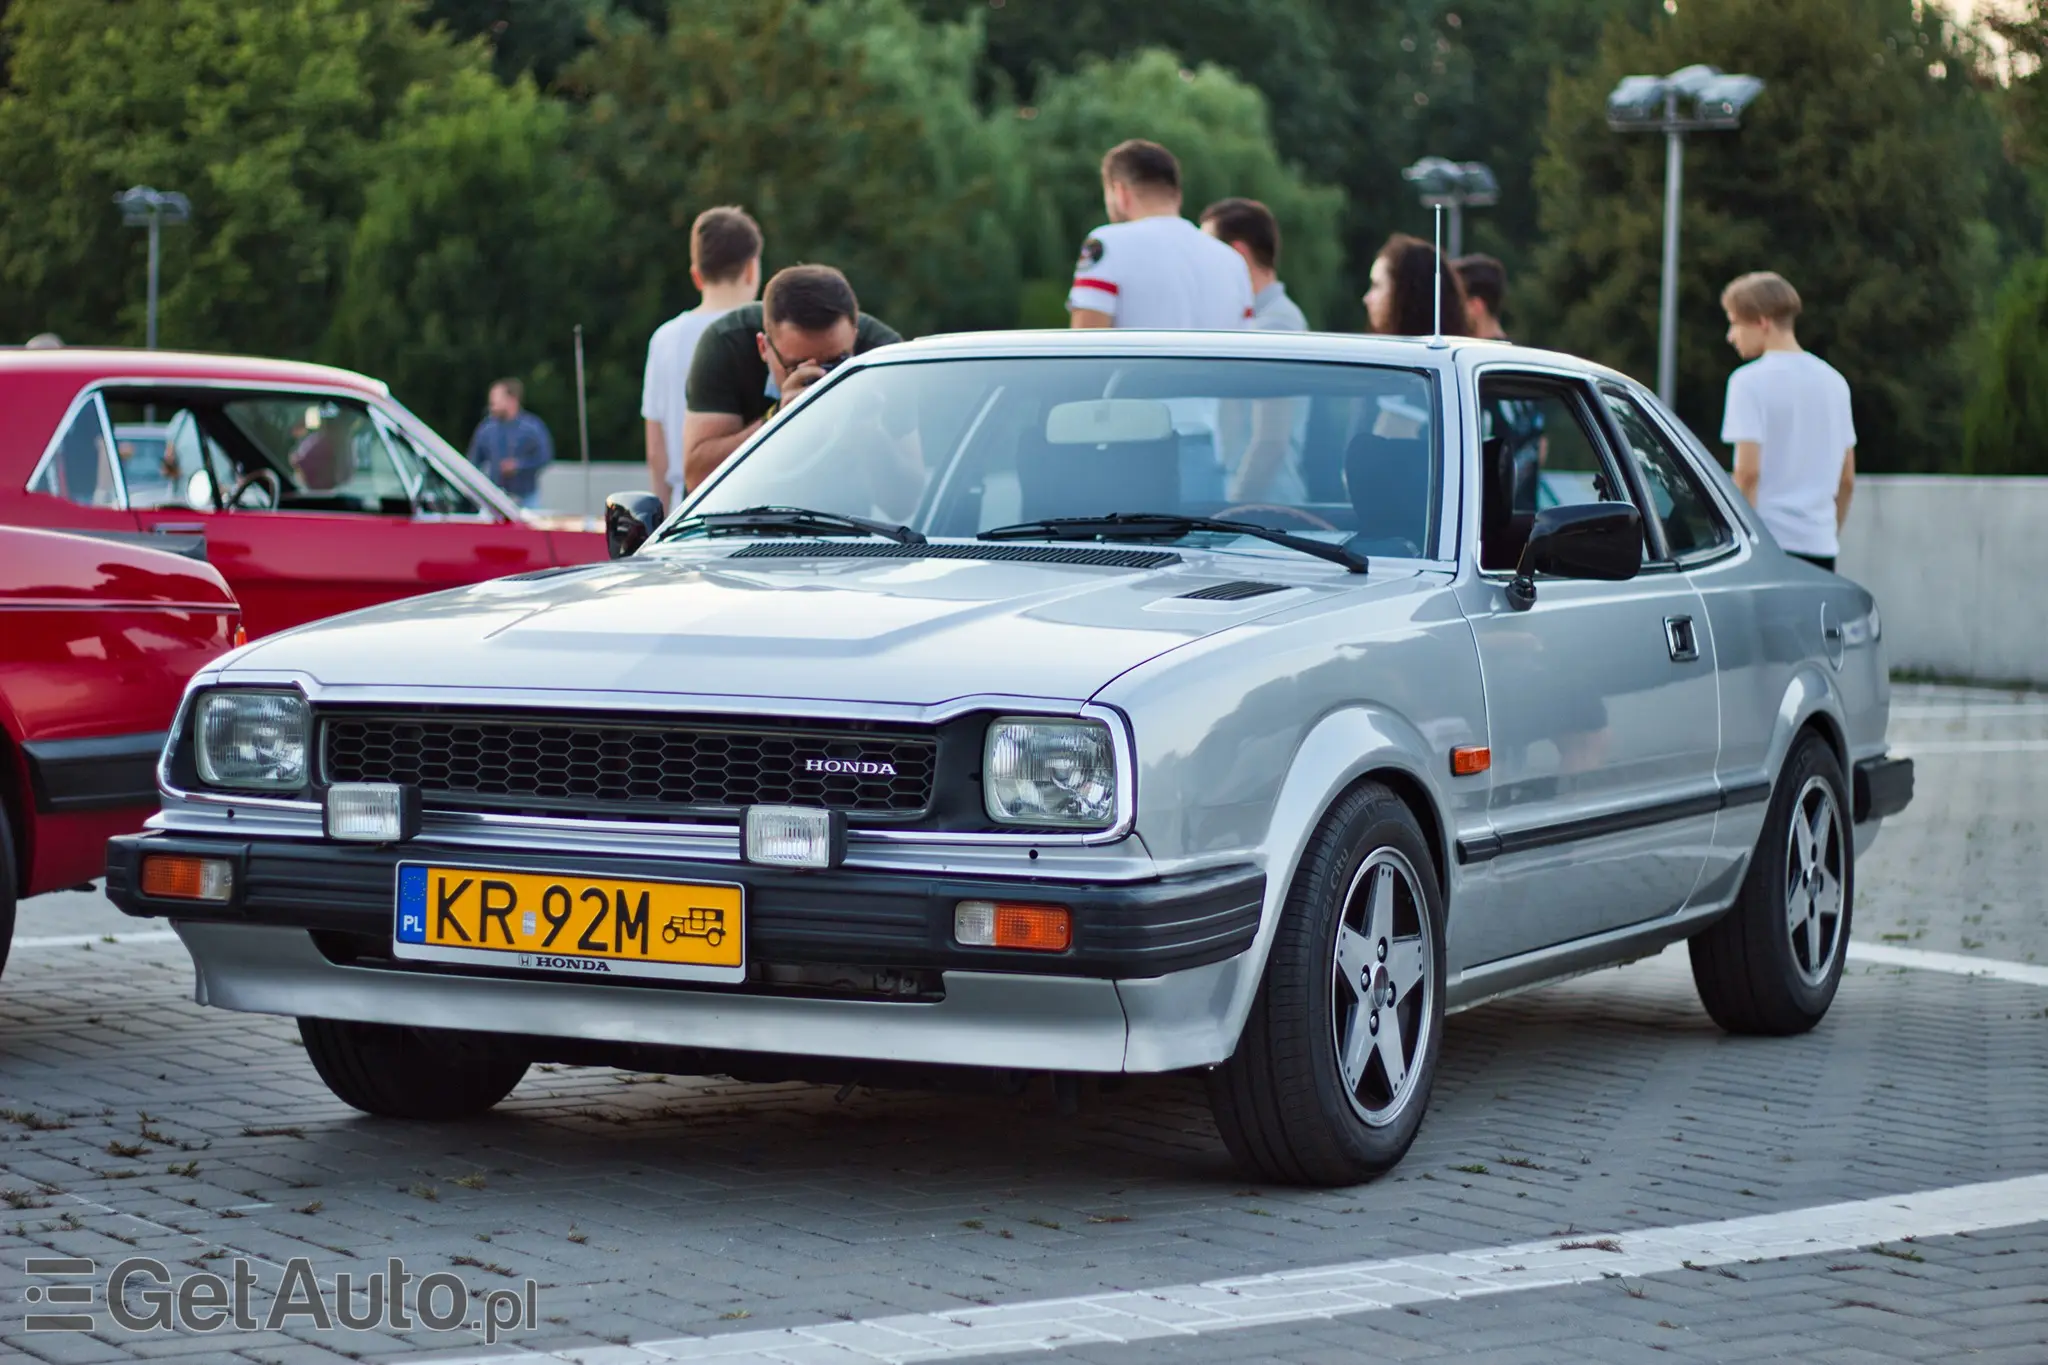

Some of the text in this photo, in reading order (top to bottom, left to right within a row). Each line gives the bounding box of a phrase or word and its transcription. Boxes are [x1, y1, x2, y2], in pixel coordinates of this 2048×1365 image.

[805, 759, 897, 775] HONDA
[403, 914, 423, 933] PL
[436, 877, 650, 955] KR 92M
[536, 956, 611, 972] HONDA
